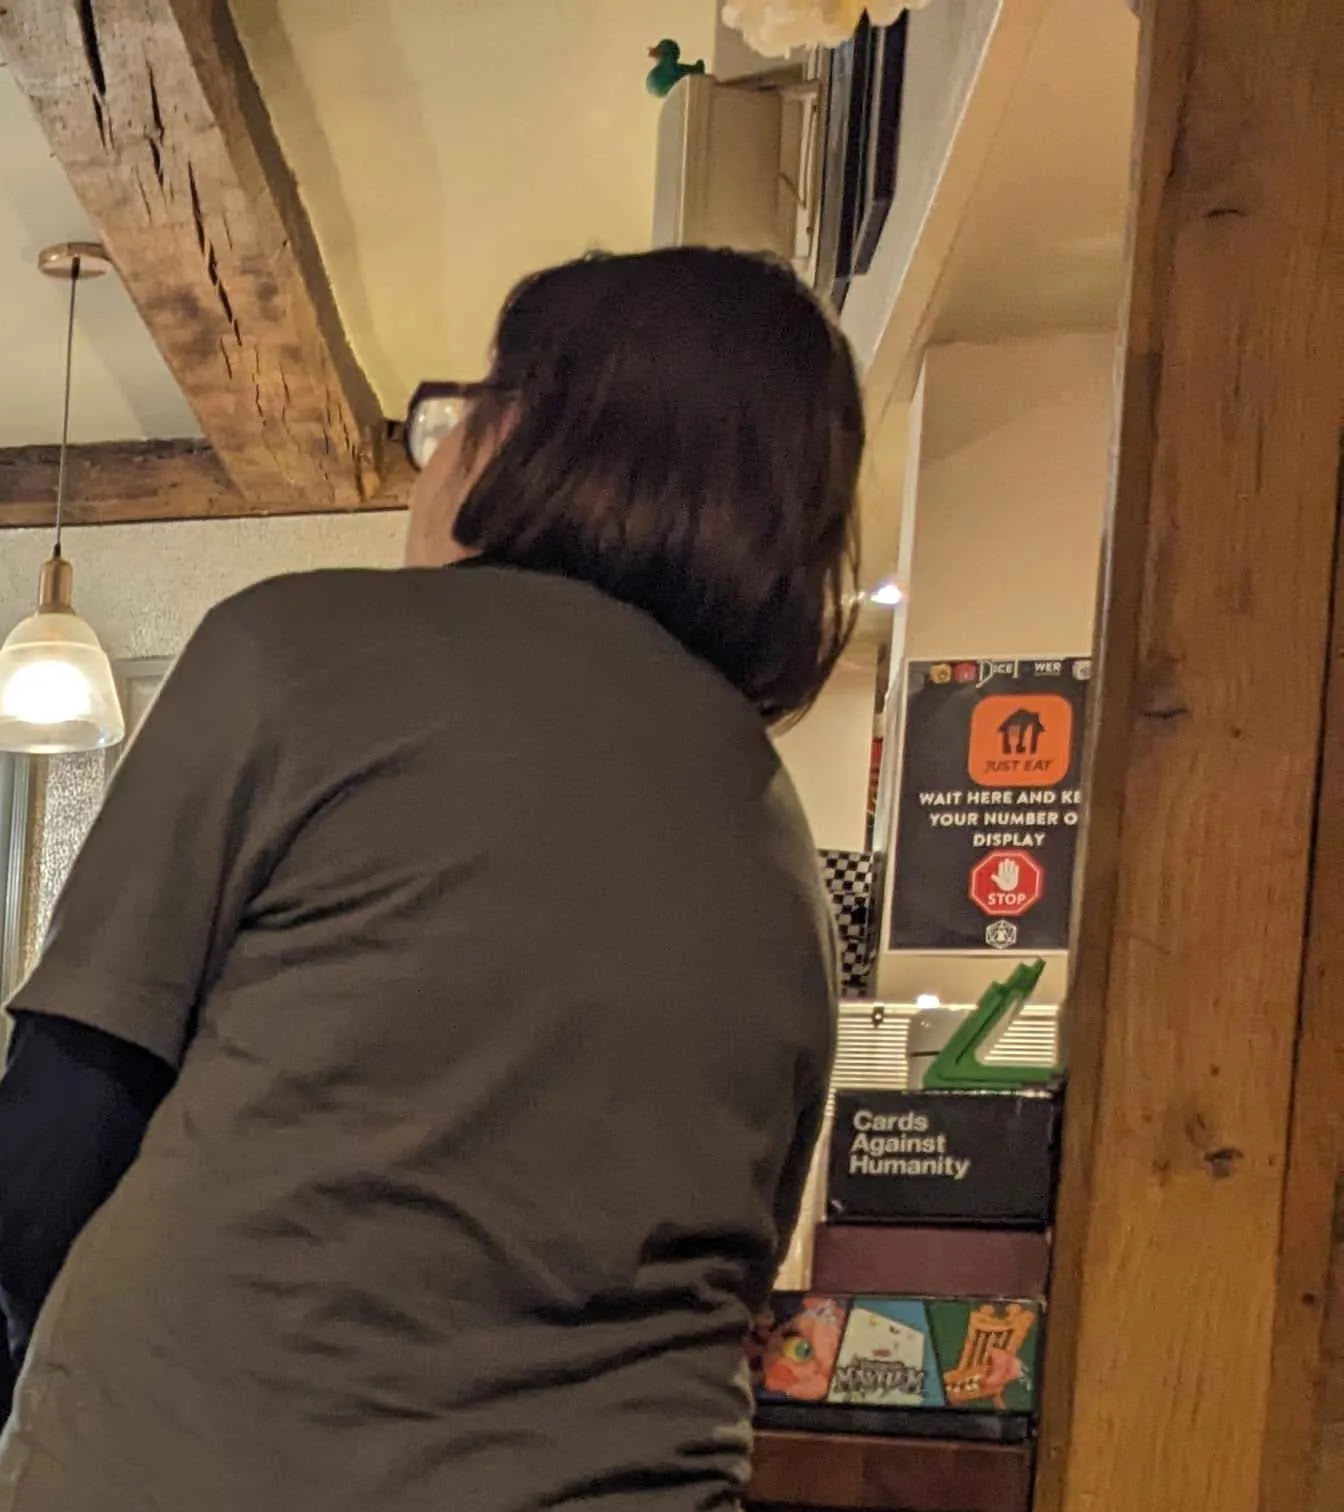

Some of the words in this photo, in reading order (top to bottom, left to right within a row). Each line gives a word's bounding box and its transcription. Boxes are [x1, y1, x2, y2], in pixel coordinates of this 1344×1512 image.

[983, 759, 1019, 774] JUST
[1023, 759, 1054, 772] EAT
[919, 791, 962, 806] WAIT
[966, 791, 1013, 805] HERE
[1016, 790, 1056, 805] AND
[929, 811, 979, 827] YOUR
[983, 811, 1059, 826] NUMBER
[972, 832, 1046, 847] DISPLAY
[987, 892, 1026, 906] STOP
[853, 1108, 929, 1132] Cards
[850, 1131, 948, 1157] Against
[848, 1154, 972, 1181] Humanity
